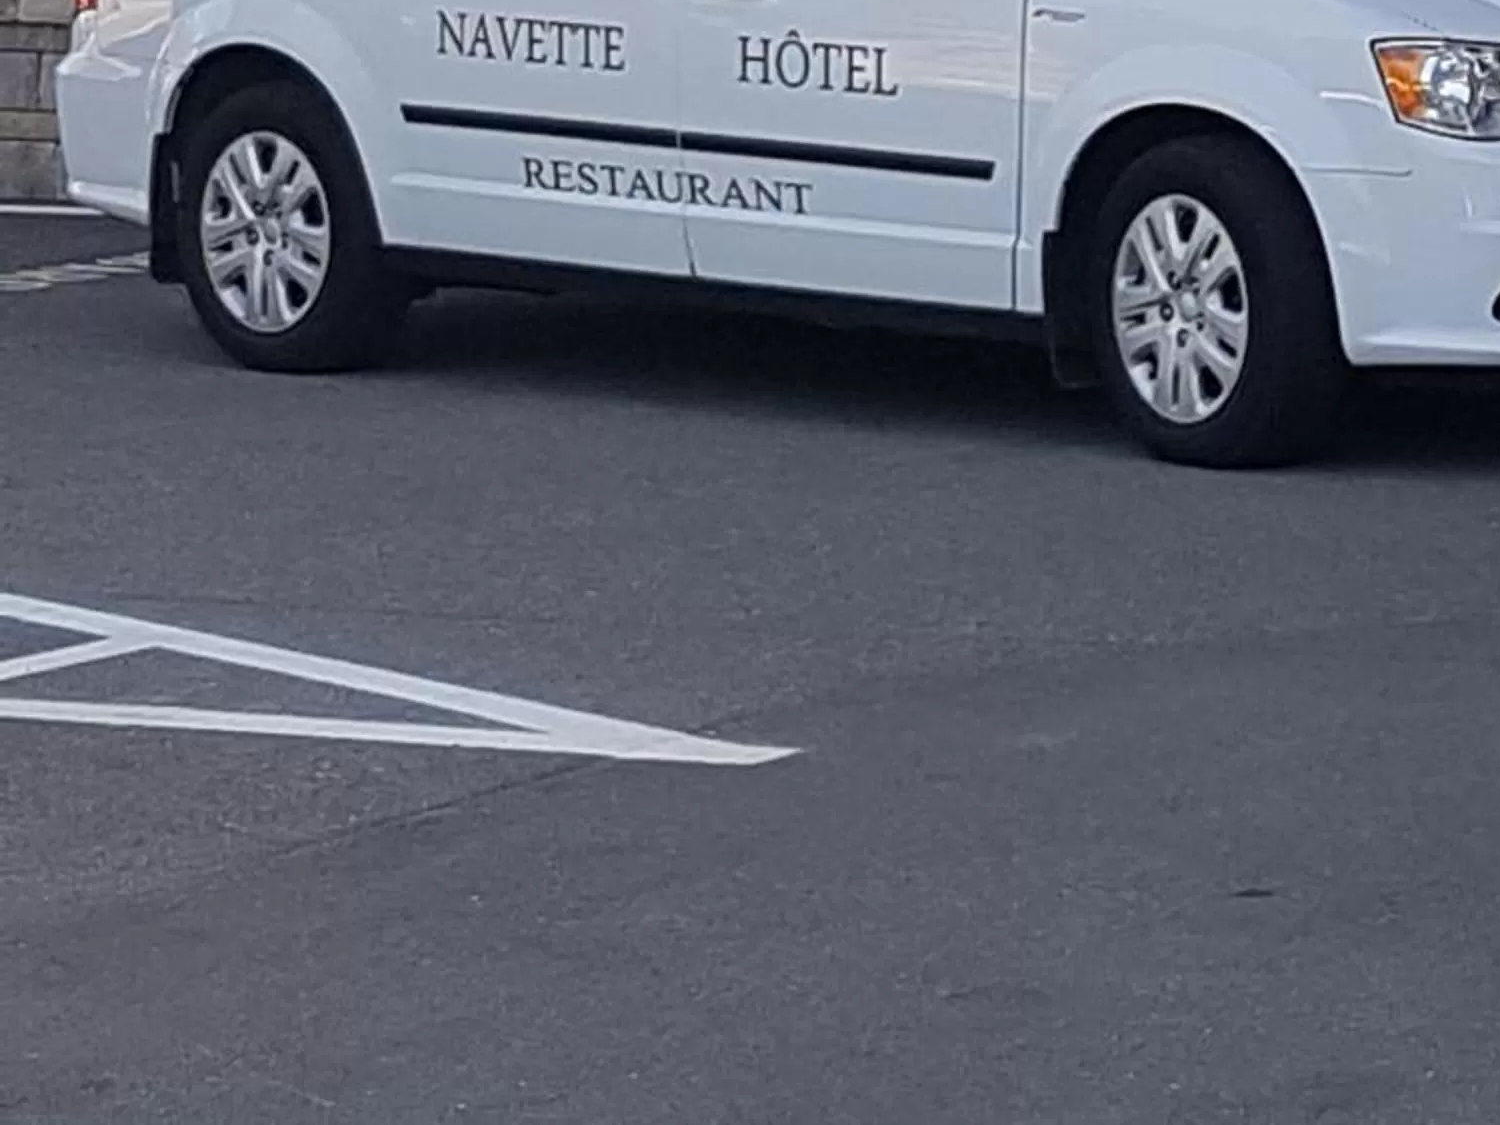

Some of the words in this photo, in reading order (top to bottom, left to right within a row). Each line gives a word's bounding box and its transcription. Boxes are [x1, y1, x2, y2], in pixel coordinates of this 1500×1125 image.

[437, 10, 625, 72] NAVETTE
[737, 30, 898, 96] HÔTEL
[522, 157, 812, 215] RESTAURANT
